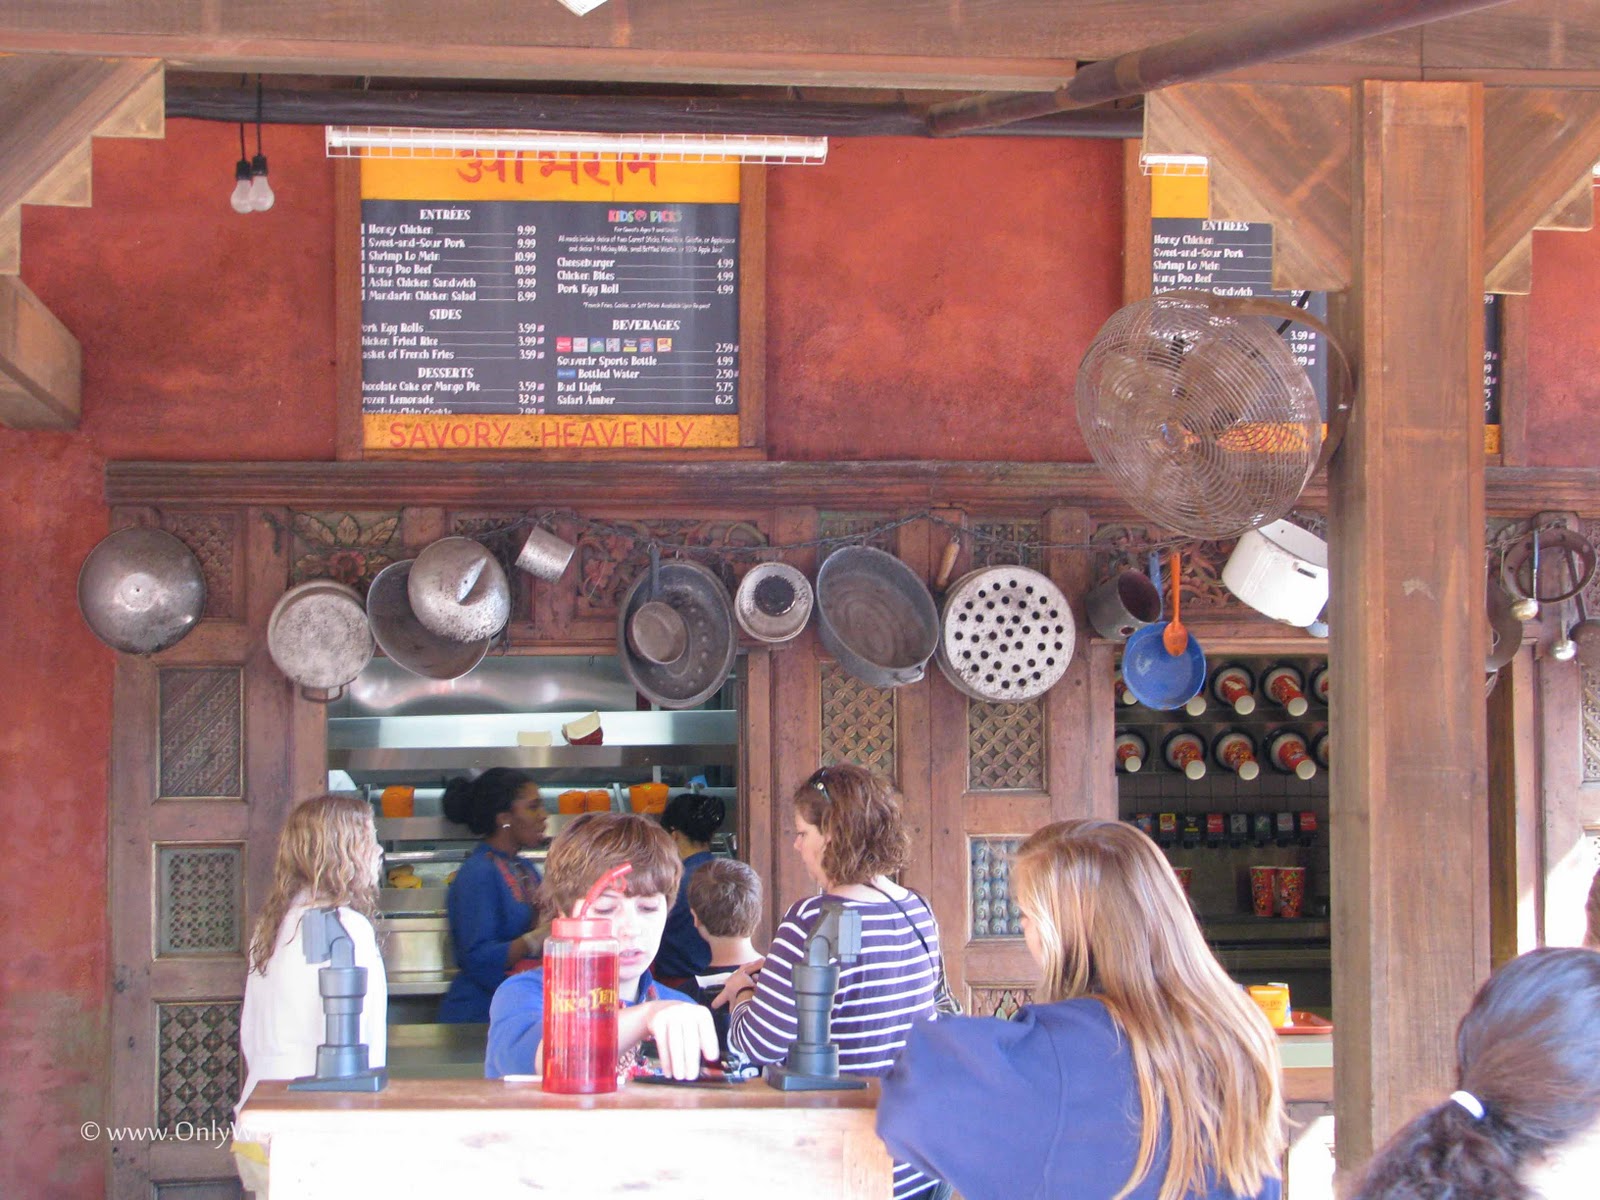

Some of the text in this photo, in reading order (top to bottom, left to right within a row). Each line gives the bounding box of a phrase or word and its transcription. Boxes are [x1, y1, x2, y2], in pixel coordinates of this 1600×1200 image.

[368, 224, 537, 236] Honey Chicken 9.99
[368, 238, 537, 248] Sweet-and-Sour Pork 9.99
[1153, 235, 1215, 246] Honey Chicken
[368, 251, 537, 263] Shrimp Lo Mein 10.99
[1152, 248, 1244, 258] Sweet-and-Sour Pork
[557, 257, 734, 270] Cheeseburger 4.99
[1153, 261, 1221, 272] Shrimp Lo Mein
[368, 264, 537, 277] Kung Pao Beef 10.99
[557, 271, 734, 282] Chicken Bites 4.99
[1152, 273, 1214, 285] Kung Pao Beef
[368, 278, 537, 288] Asian Chicken Sandwich 9.99
[557, 284, 734, 296] Pork Egg Roll 4.99
[1212, 287, 1253, 297] Sandwich
[1290, 289, 1306, 297] 9.9
[368, 291, 537, 301] Mandarin Chicken Salad 8.99
[429, 309, 463, 320] SIDES
[362, 323, 537, 335] ork Egg Rolls 3.99
[612, 320, 681, 330] BEVERAGES
[362, 336, 537, 346] hicken Fried Rice 3.99
[1290, 331, 1308, 341] 3.99
[715, 343, 734, 353] 2.59
[1290, 343, 1308, 353] 3.99
[362, 349, 537, 359] asket of French Fries 3.99
[557, 356, 734, 368] Souvenir Sports Bottle 4.99
[417, 367, 475, 379] DESSERTS
[578, 369, 610, 379] Bottled
[613, 369, 640, 379] Water
[715, 369, 734, 379] 2.50
[362, 381, 537, 395] hocolate Cake or Mango Pie 3.59
[557, 382, 734, 394] Bud Light 5.75
[362, 394, 537, 405] rozen Lemonade 3.29
[557, 394, 734, 405] Safari Amber 6.25
[362, 407, 423, 415] hocolate-Chip
[518, 407, 537, 415] 299
[389, 420, 696, 448] SAVORY HEAVENLY
